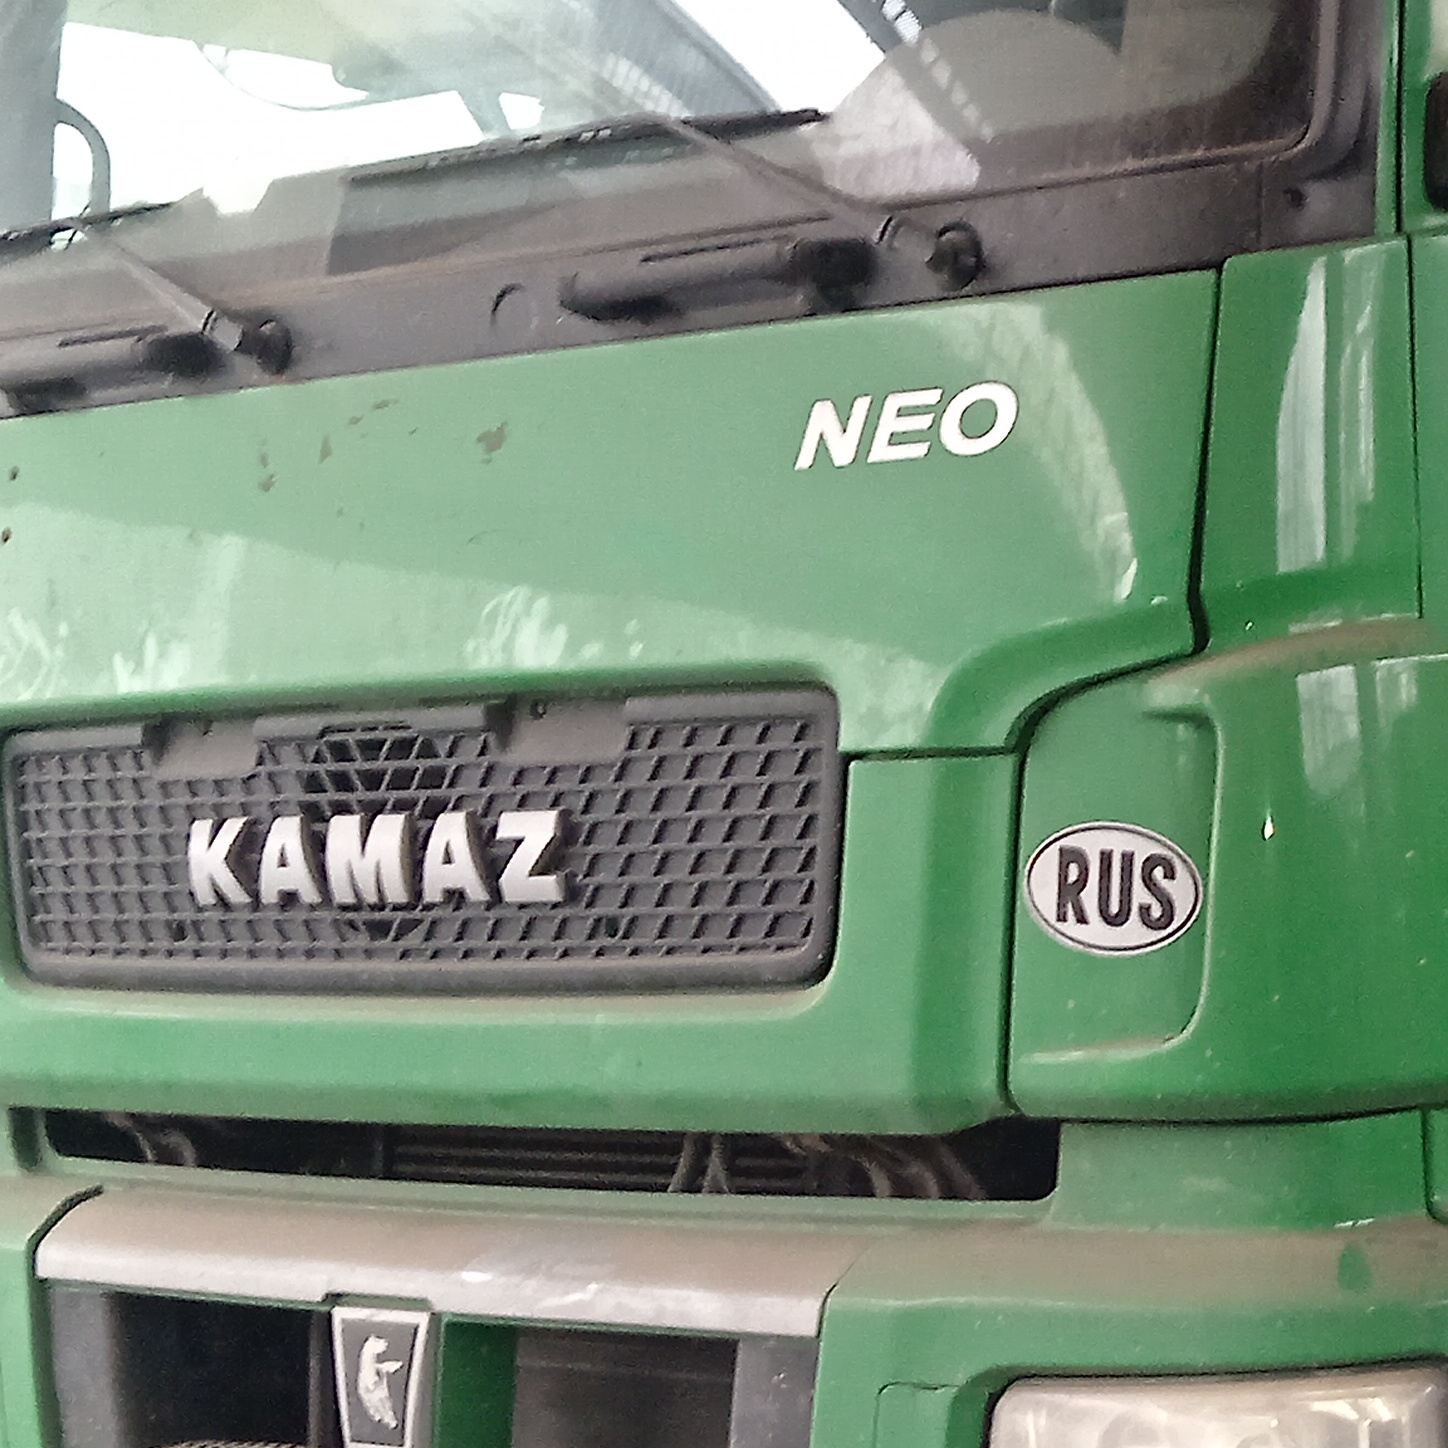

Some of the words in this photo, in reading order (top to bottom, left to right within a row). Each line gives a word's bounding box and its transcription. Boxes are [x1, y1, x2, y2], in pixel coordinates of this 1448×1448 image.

[793, 379, 1020, 471] NEO
[188, 808, 568, 906] KAMAZ
[1055, 845, 1177, 931] RUS
